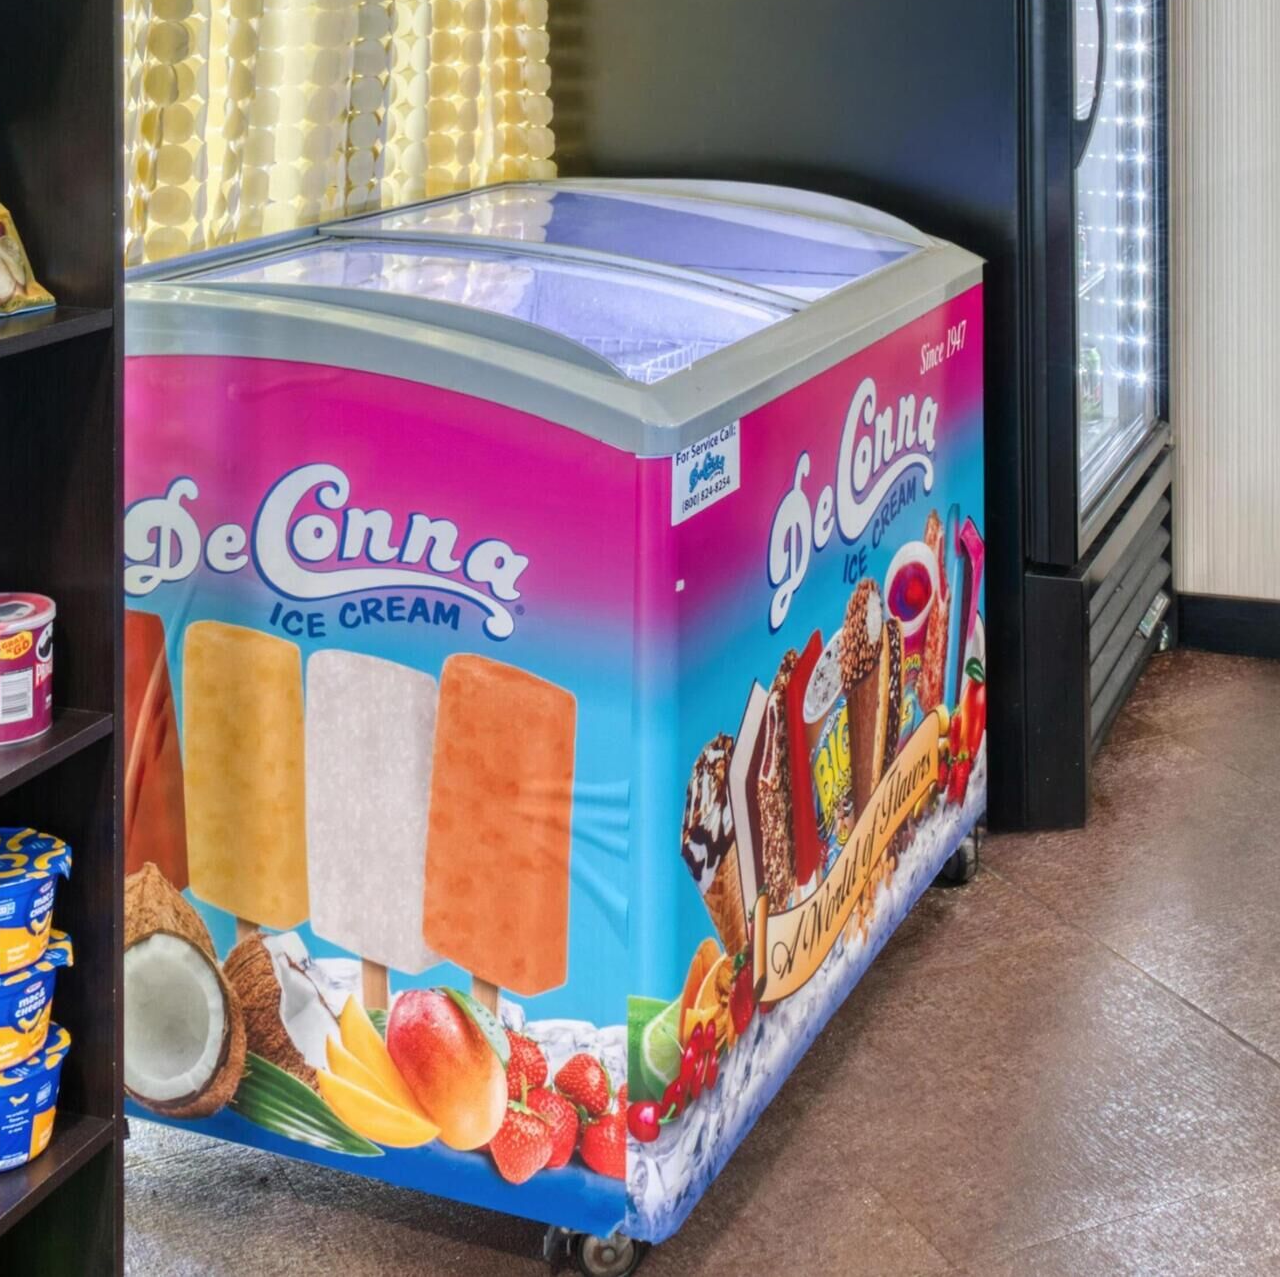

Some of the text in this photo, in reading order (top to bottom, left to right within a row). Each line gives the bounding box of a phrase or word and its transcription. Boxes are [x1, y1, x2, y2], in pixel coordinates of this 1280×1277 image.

[920, 323, 966, 375] Since 1947
[676, 424, 736, 466] For Service Call:
[843, 476, 916, 584] ICE CREAM
[269, 596, 461, 638] ICE CREAM
[772, 751, 932, 979] A World of Flavors
